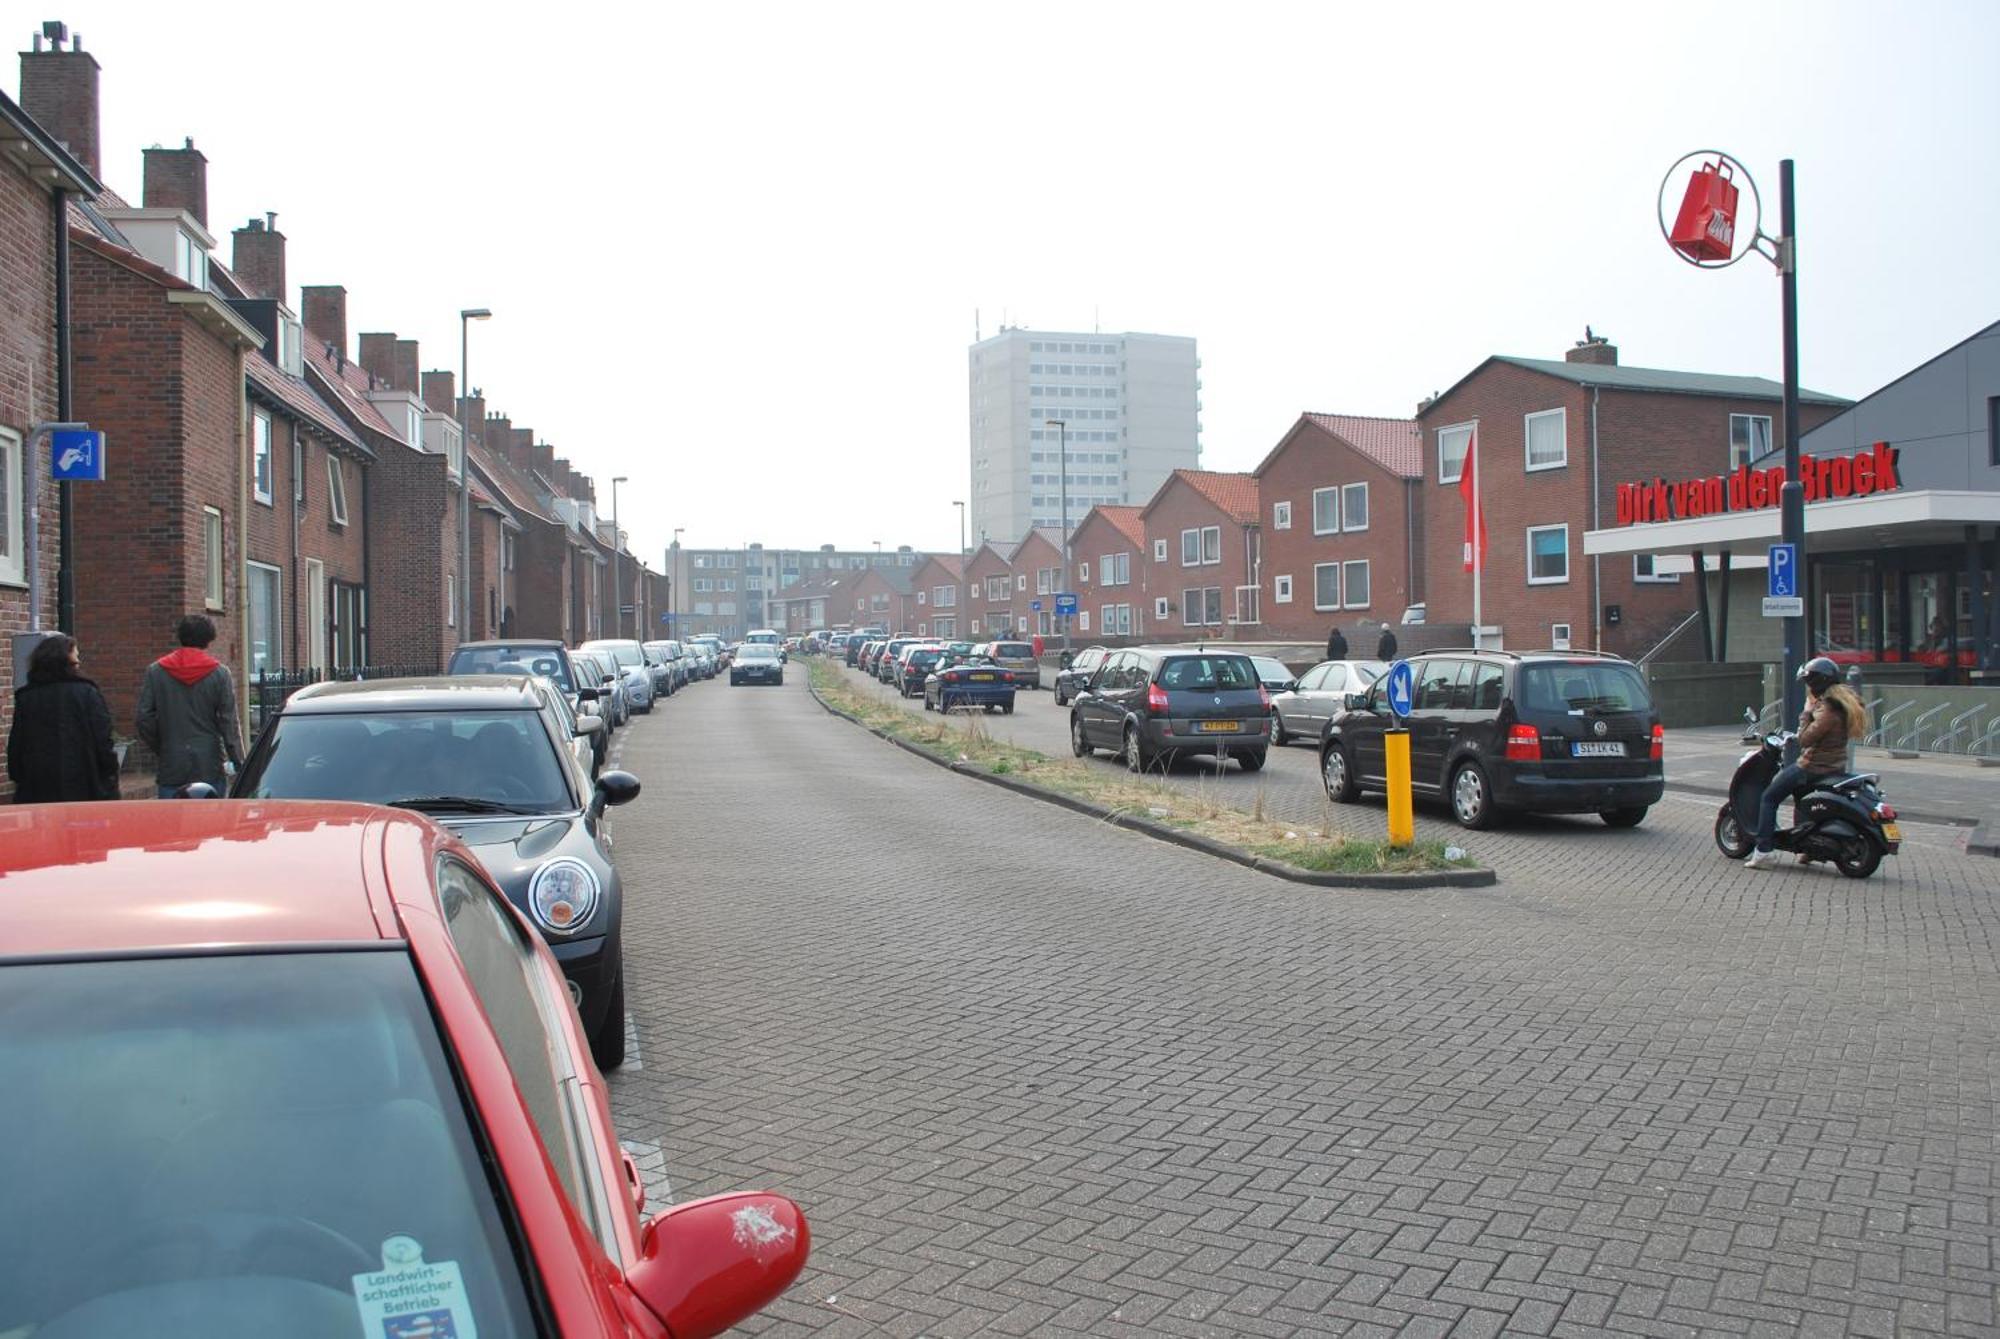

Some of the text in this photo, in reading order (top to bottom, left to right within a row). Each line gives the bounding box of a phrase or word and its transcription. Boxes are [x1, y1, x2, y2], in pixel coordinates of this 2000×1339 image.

[1616, 440, 1898, 528] Dirk van den Broek
[1774, 549, 1789, 576] P
[367, 1266, 443, 1287] Landwirt-
[362, 1280, 453, 1302] schaftlicher
[383, 1296, 441, 1314] Betrieb
